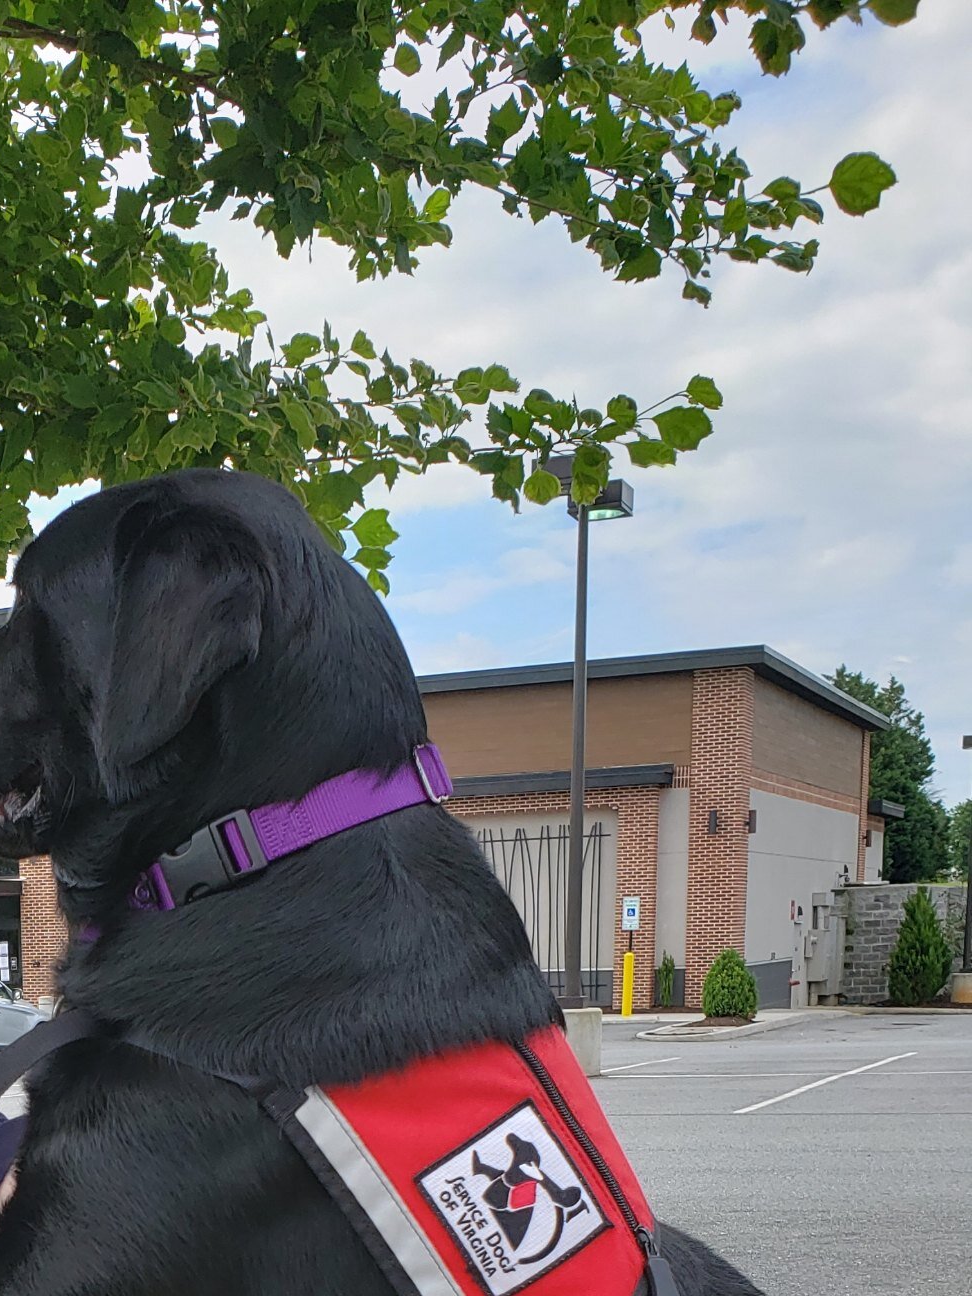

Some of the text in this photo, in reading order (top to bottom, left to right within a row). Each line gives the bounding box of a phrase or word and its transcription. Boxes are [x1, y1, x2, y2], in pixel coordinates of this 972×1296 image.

[439, 1190, 497, 1278] OF VIRGINIA
[445, 1176, 516, 1274] SERVICE DOGS
